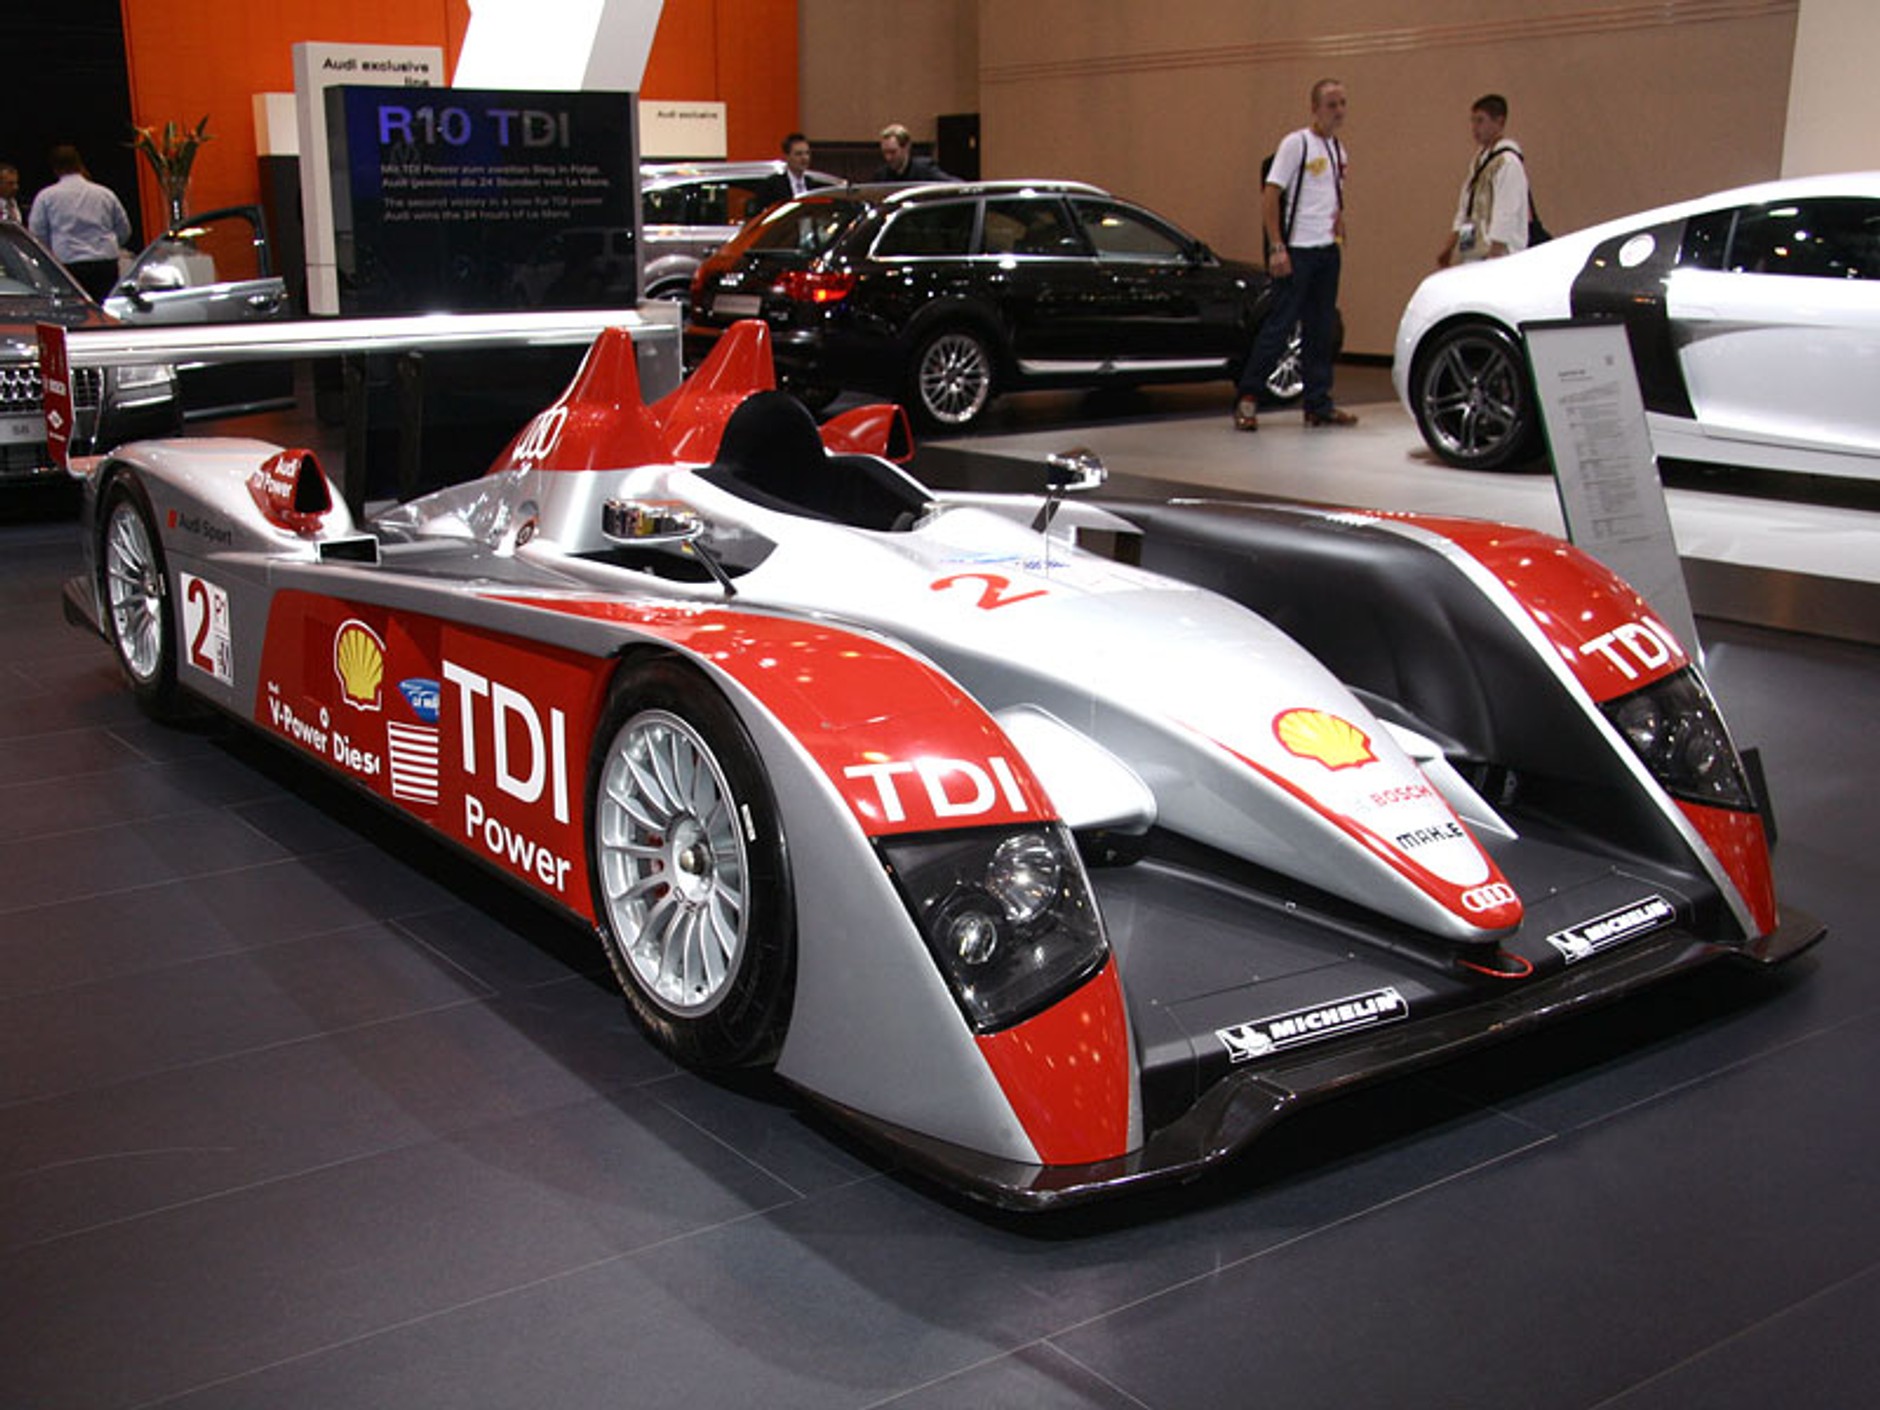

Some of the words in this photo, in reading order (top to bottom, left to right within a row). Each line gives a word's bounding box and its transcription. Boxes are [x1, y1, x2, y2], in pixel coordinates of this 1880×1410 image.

[323, 57, 357, 71] Audi
[362, 60, 429, 73] exclusive
[379, 105, 471, 145] R10
[486, 109, 570, 149] TDI
[179, 513, 201, 533] Audi
[203, 519, 232, 545] Sport
[930, 573, 1050, 610] 2
[188, 578, 214, 673] 2
[1579, 615, 1683, 680] TDI
[268, 696, 328, 753] V-Power
[443, 660, 569, 824] TDI
[843, 756, 1028, 822] TDI
[1369, 785, 1433, 807] BOSCH
[465, 794, 571, 892] Power
[1396, 822, 1463, 850] MAHLE
[1584, 900, 1668, 941] MICHELIN
[1269, 994, 1398, 1040] MICHELIN
